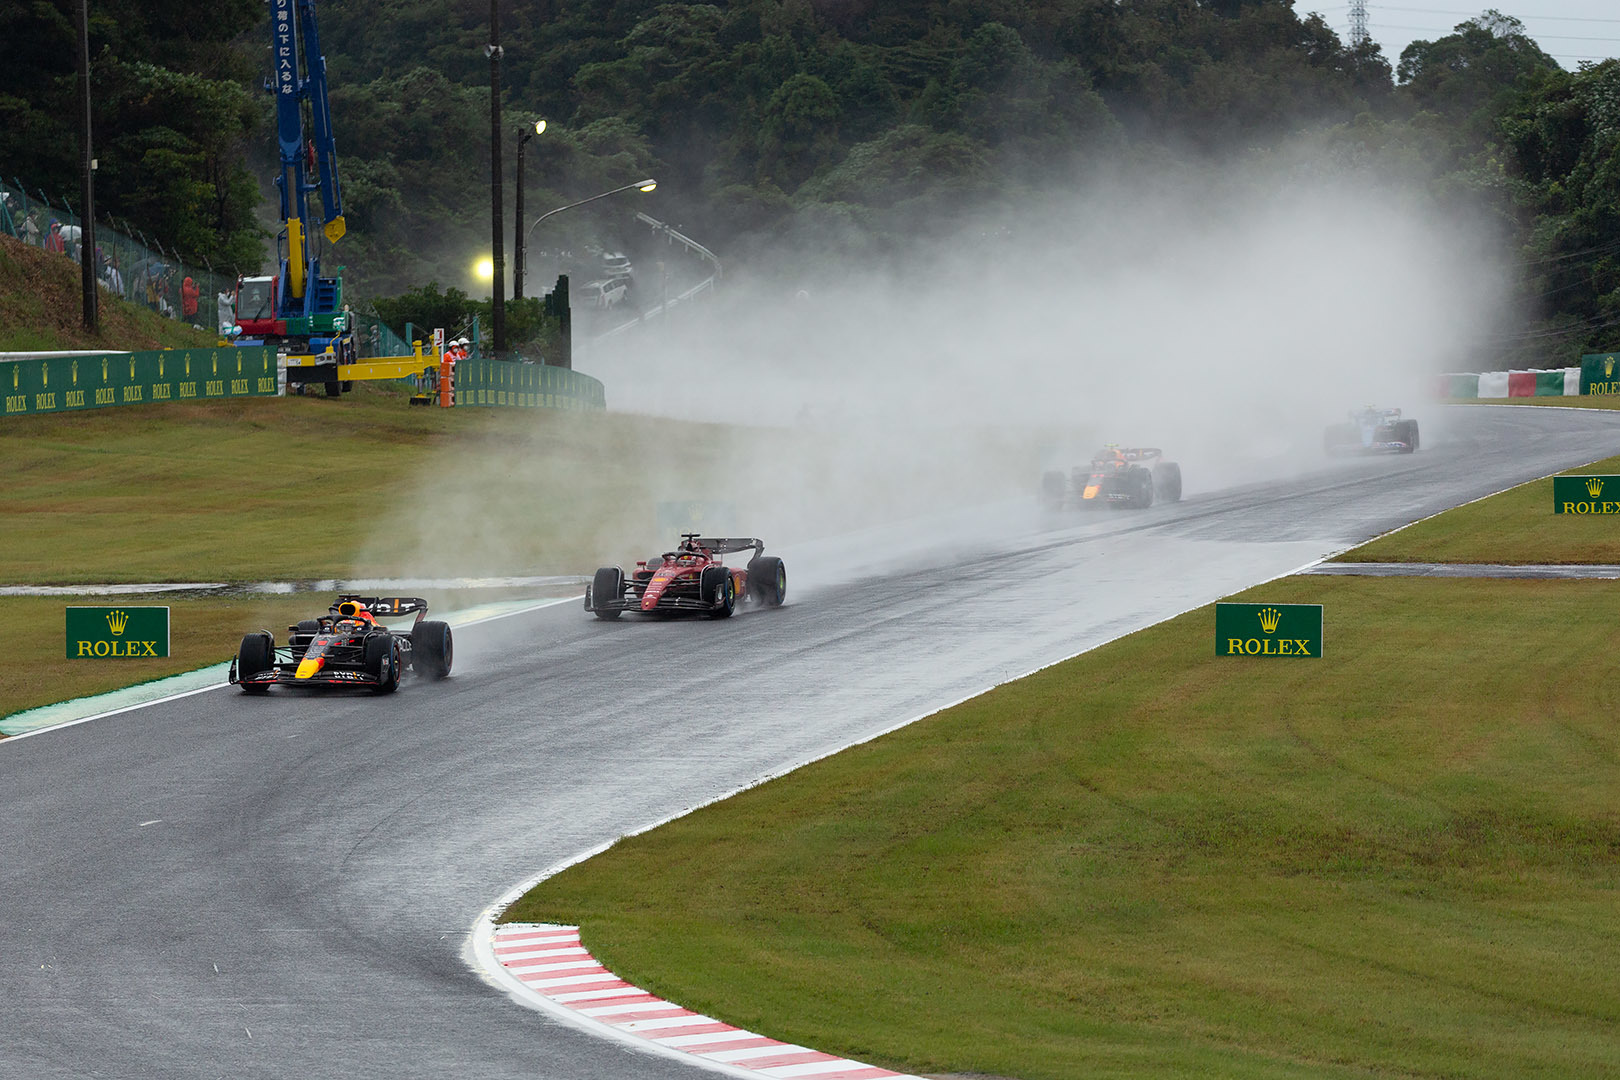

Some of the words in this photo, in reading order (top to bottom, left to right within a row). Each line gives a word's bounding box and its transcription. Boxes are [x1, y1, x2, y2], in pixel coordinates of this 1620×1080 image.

[6, 395, 27, 413] ROLEX
[36, 392, 56, 410] ROLEX
[66, 390, 85, 407] ROLEX
[95, 387, 115, 404] ROLEX
[123, 385, 143, 402] ROLEX
[152, 383, 171, 399] ROLEX
[179, 381, 197, 397] ROLEX
[206, 380, 224, 396] ROLEX
[231, 379, 248, 394] ROLEX
[258, 377, 275, 393] ROLEX
[1590, 382, 1620, 396] ROLE
[76, 640, 158, 656] ROLEX
[1227, 638, 1311, 655] ROLEX
